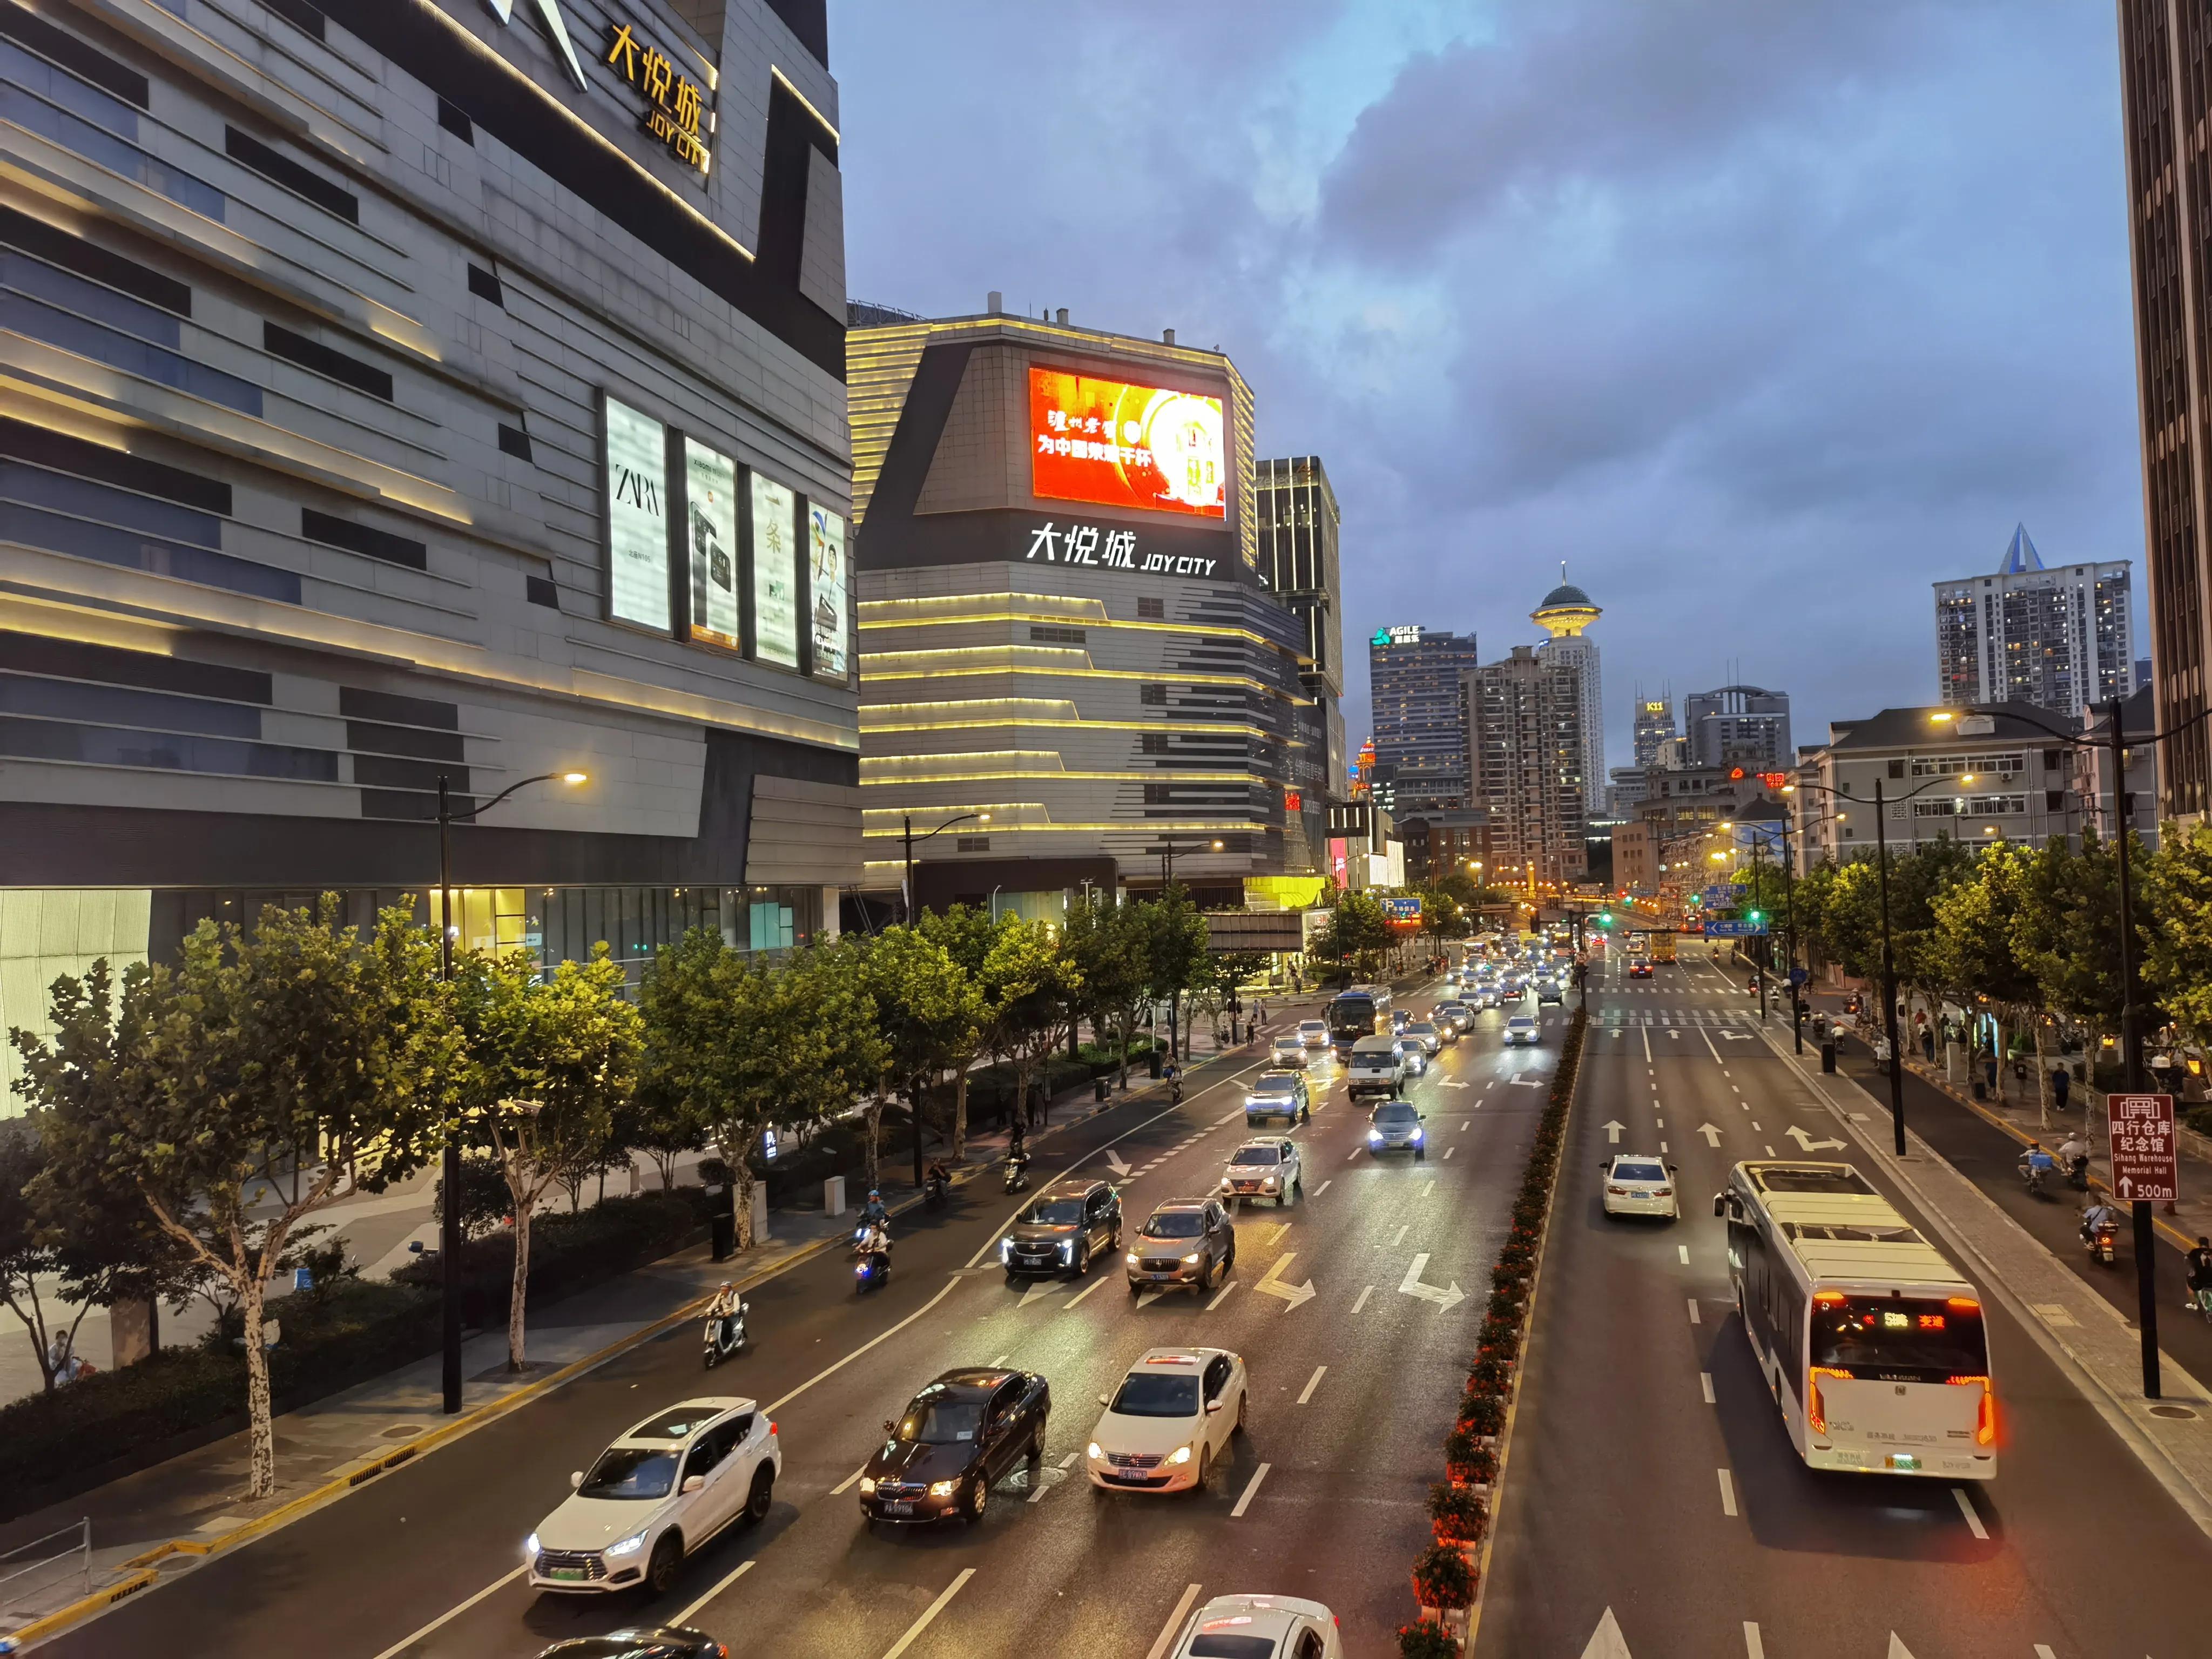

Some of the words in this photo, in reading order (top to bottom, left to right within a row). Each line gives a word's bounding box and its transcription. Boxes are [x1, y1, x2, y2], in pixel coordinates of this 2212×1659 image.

[608, 24, 702, 135] 大悦城
[646, 111, 675, 144] JOY
[676, 132, 707, 172] CITY
[616, 463, 659, 517] ZARA
[1027, 522, 1136, 569] 大悦城
[1141, 554, 1175, 571] JOY
[1176, 557, 1216, 576] CITY
[1389, 625, 1419, 636] AGILE
[1647, 702, 1663, 711] K11
[2112, 1121, 2171, 1136] 四行仓库
[2121, 1137, 2164, 1152] 纪念馆
[2114, 1154, 2136, 1164] Sihang
[2139, 1154, 2173, 1162] Warehouse
[2122, 1166, 2152, 1174] Memorial
[2155, 1166, 2167, 1175] Hall
[2137, 1185, 2172, 1197] 500m
